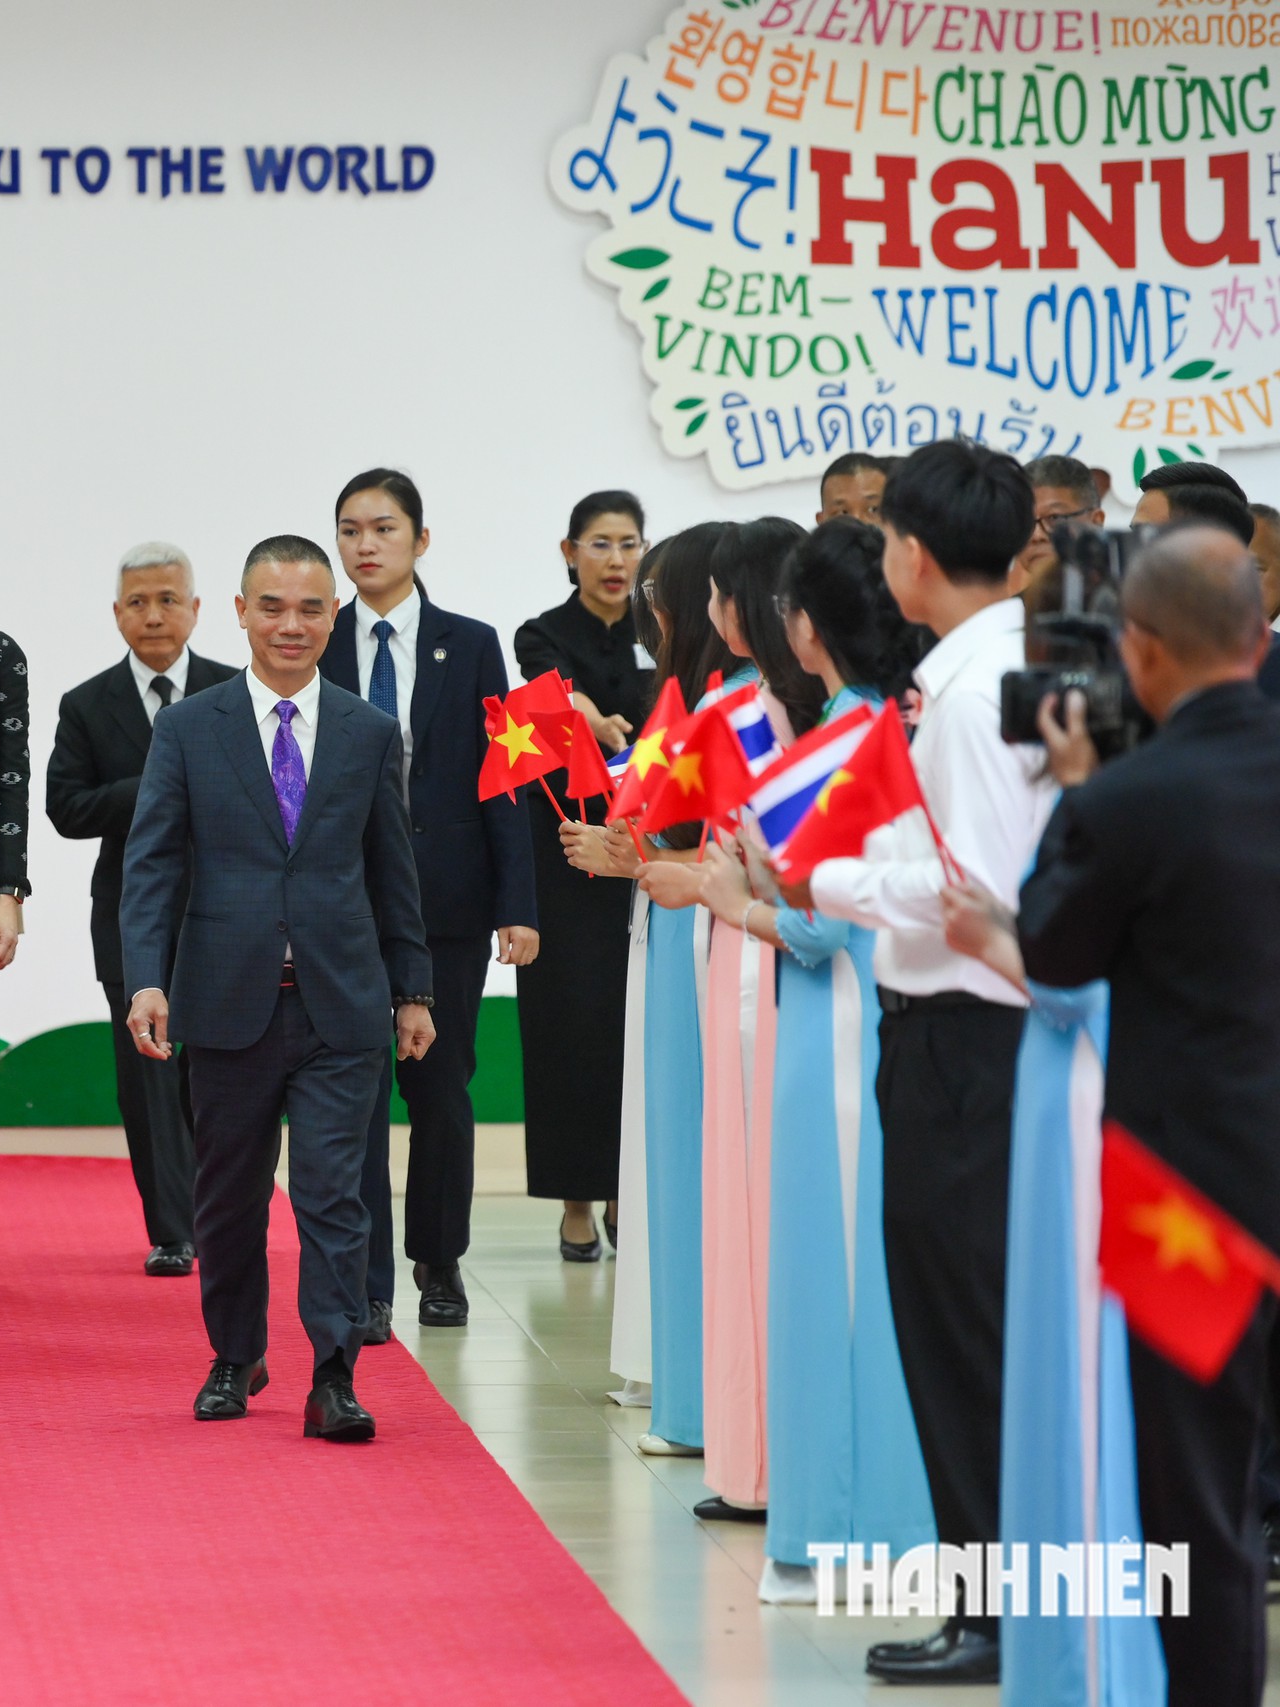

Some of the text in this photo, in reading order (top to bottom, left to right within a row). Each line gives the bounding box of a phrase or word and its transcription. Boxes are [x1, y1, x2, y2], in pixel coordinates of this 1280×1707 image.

[759, 0, 1102, 55] BIENVENUE!
[663, 9, 928, 137] 환영합니다
[934, 63, 1276, 149] CHÀO MỪNG
[40, 147, 111, 196] TO
[126, 147, 224, 197] THE
[244, 145, 436, 196] WORLD
[653, 313, 876, 379] VINDO!
[871, 280, 1191, 399] WELCOME
[1210, 275, 1280, 350] 欢
[1115, 369, 1280, 437] BENV
